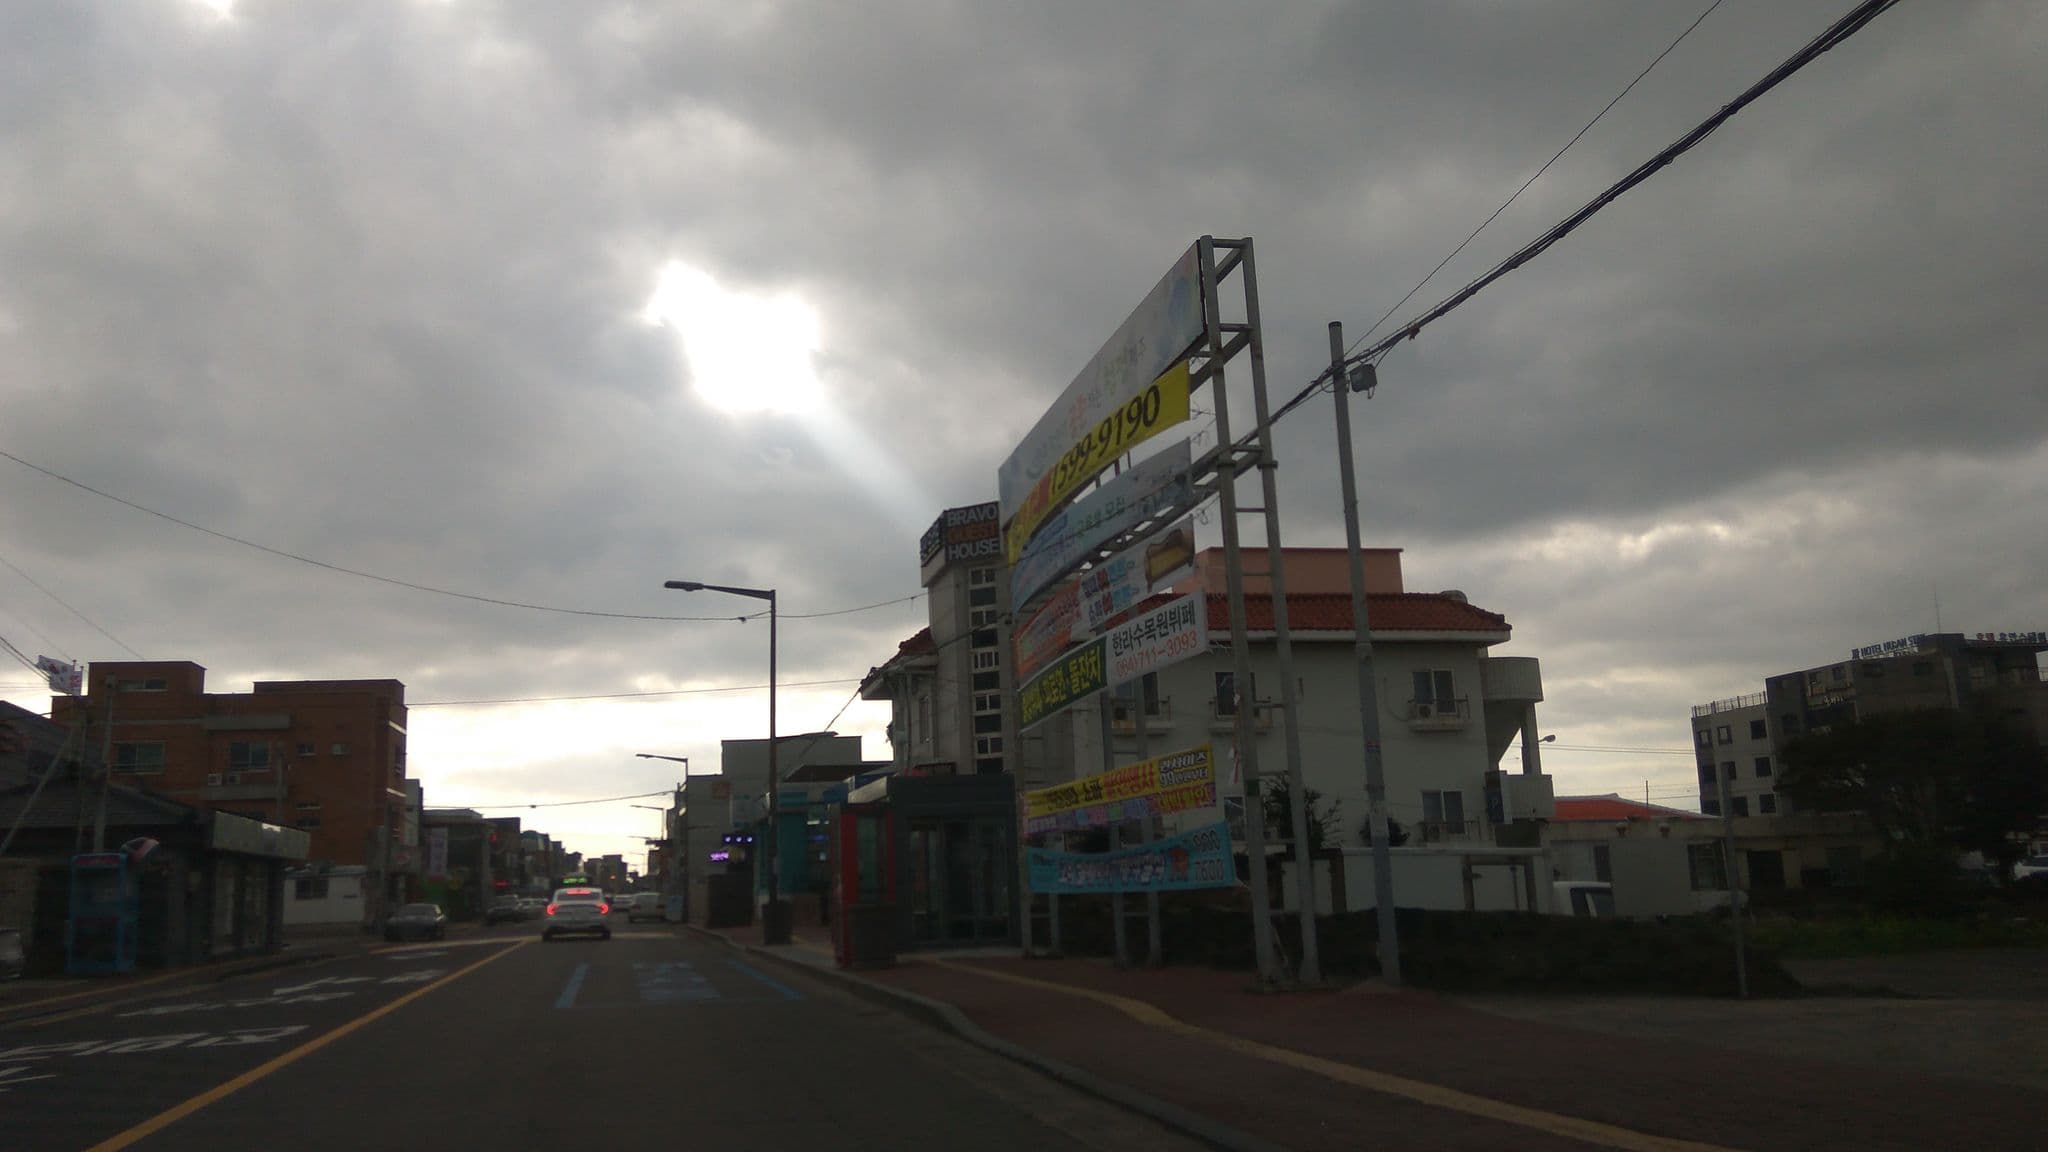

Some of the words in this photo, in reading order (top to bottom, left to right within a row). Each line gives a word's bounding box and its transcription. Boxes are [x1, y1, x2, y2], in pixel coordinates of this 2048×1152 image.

[947, 503, 998, 527] BRAVO
[948, 520, 998, 544] GUEST
[948, 538, 1000, 560] HOUSE
[1112, 600, 1196, 656] 한라수목원뷔페
[1861, 642, 1882, 657] HOTEL
